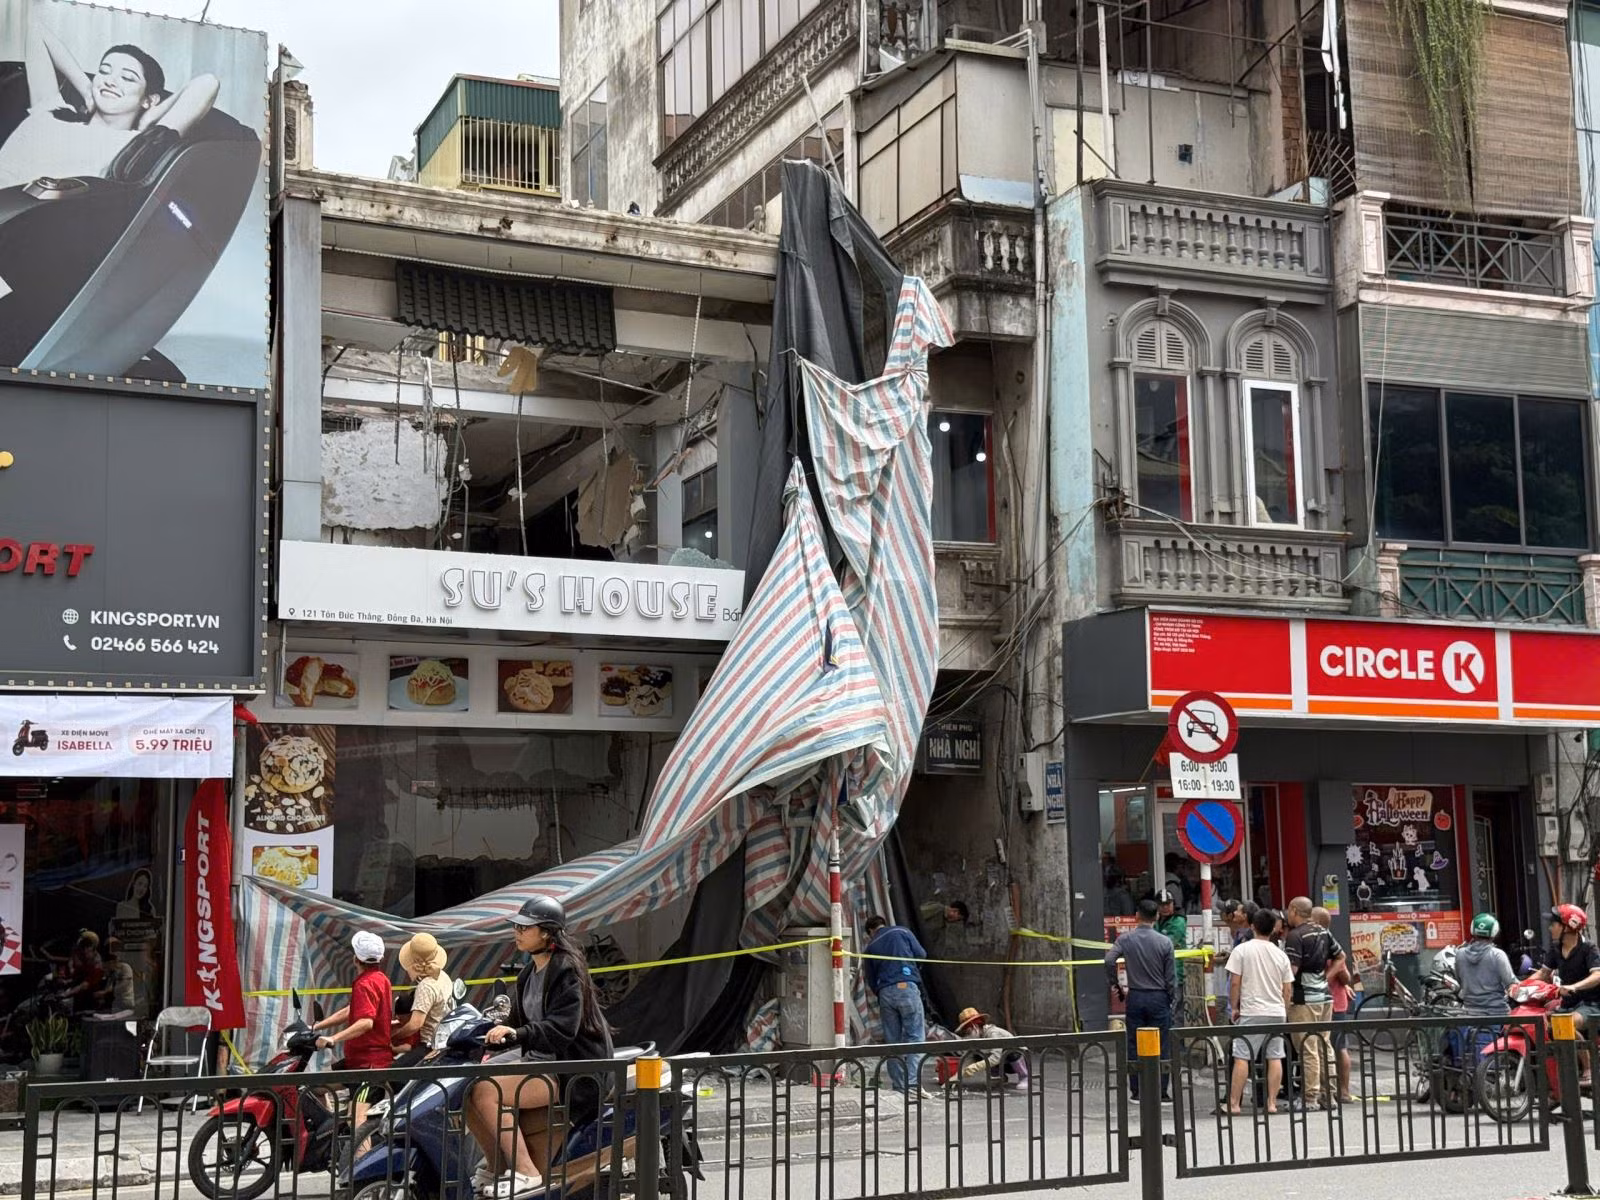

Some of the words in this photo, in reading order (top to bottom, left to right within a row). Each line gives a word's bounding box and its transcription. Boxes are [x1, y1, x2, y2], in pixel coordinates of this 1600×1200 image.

[441, 567, 546, 612] SU'S
[559, 575, 719, 620] HOUSE
[90, 610, 220, 629] KINGSPORT.VN
[302, 608, 317, 618] 121
[320, 609, 336, 619] Tôn
[338, 610, 354, 619] Đức
[426, 615, 437, 624] Hà
[439, 615, 453, 625] Nội
[91, 636, 146, 652] 02466
[150, 638, 183, 653] 566
[187, 639, 220, 654] 424
[1319, 644, 1436, 681] CIRCLE
[1450, 648, 1484, 691] K
[61, 729, 70, 737] XE
[57, 740, 113, 751] ISABELLA
[135, 739, 169, 751] 5.99
[173, 737, 213, 754] TRIỆU
[929, 733, 952, 759] NHÀ
[954, 732, 981, 760] NGHỈ
[1181, 760, 1200, 772] 6:00
[1210, 760, 1228, 773] 9:00
[1177, 779, 1201, 791] 16:00
[1211, 779, 1235, 792] 19:30
